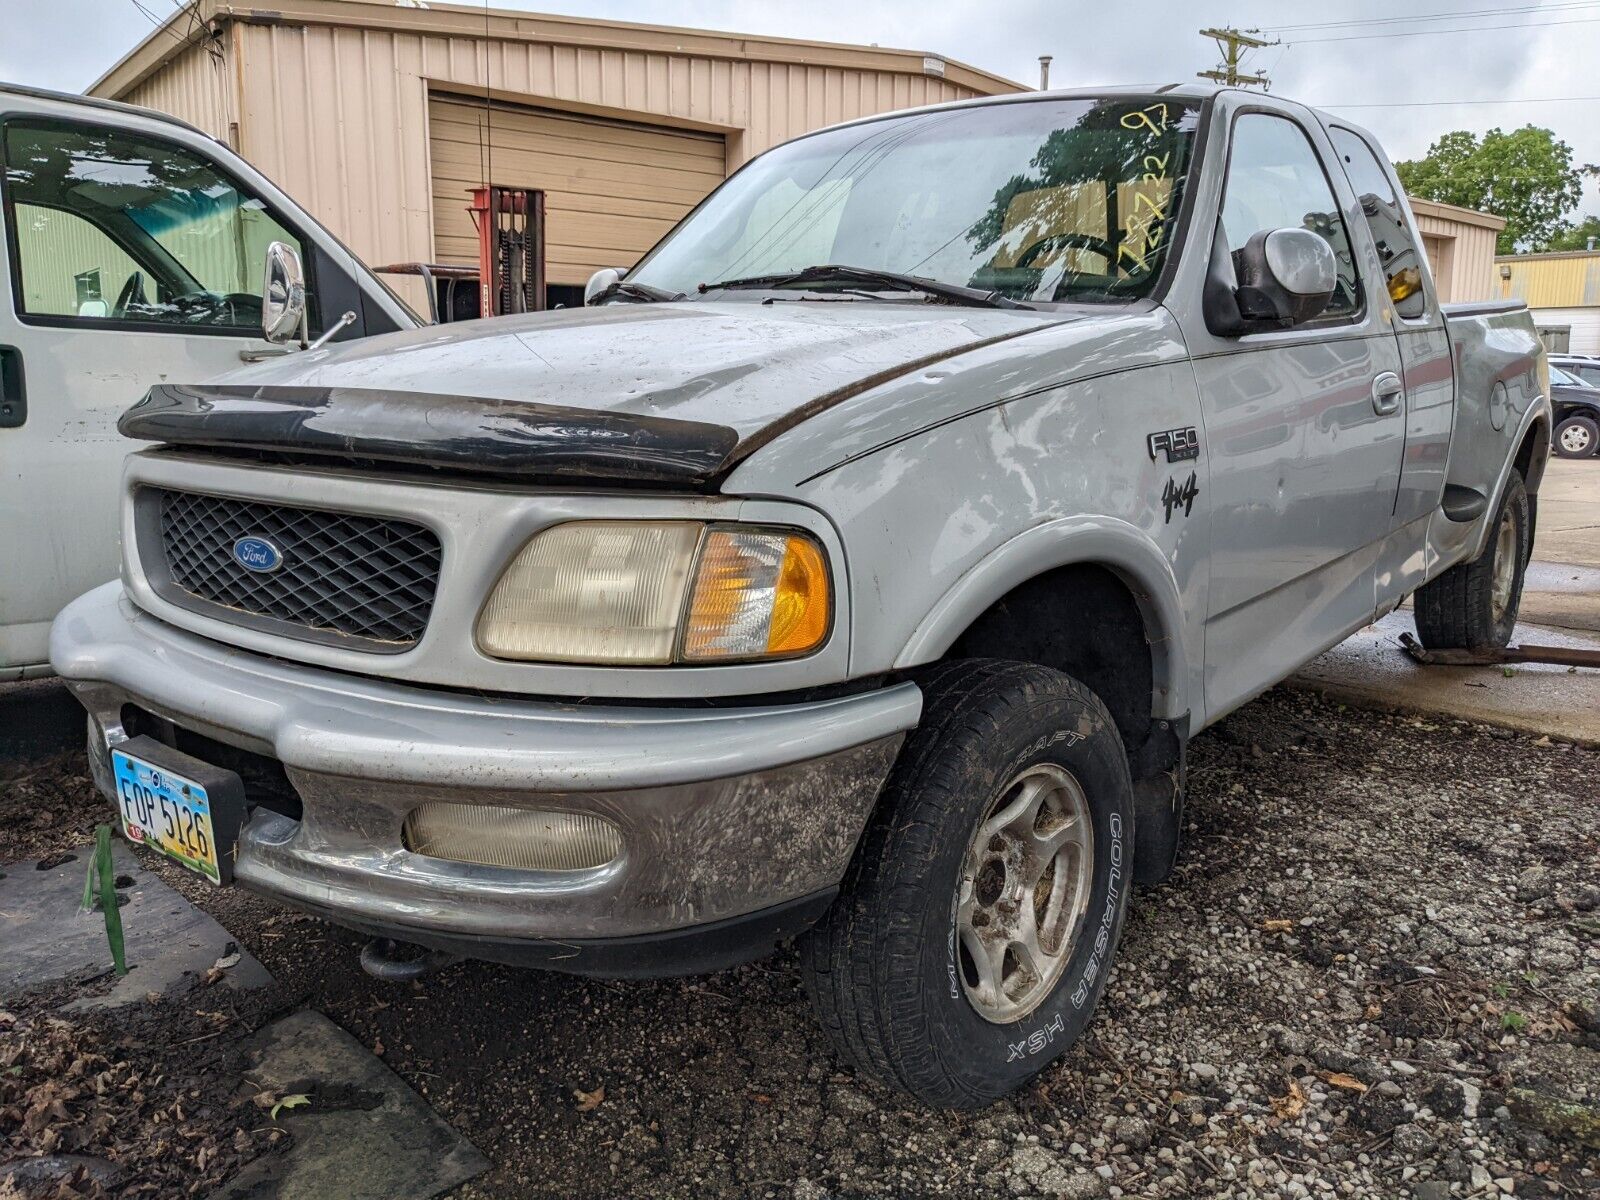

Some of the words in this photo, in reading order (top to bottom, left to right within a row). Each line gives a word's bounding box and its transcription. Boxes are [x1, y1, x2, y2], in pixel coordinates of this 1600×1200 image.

[1120, 102, 1169, 137] 97
[1161, 469, 1200, 524] 4x4
[242, 542, 268, 564] Ford
[158, 793, 209, 858] 5126
[1071, 812, 1123, 1011] COURSER
[1006, 1013, 1066, 1063] HSX
